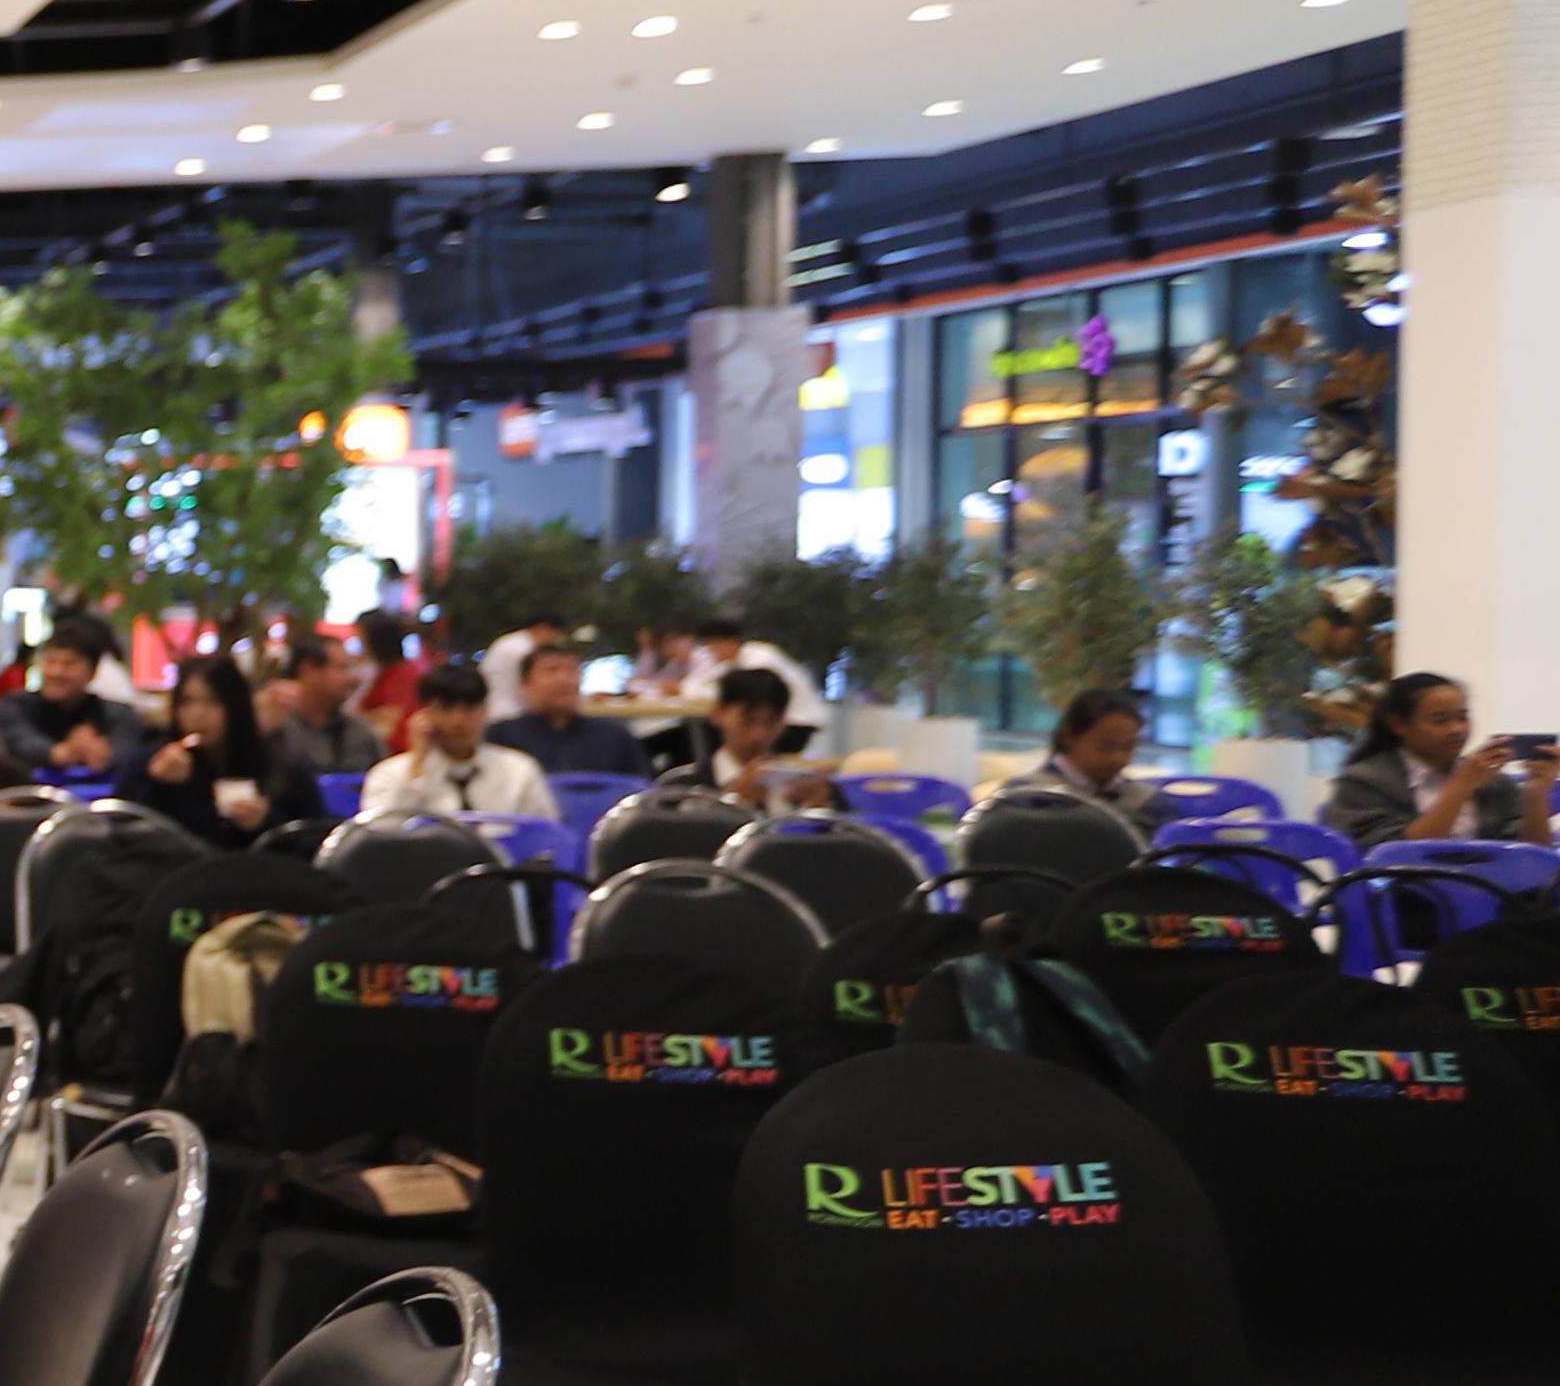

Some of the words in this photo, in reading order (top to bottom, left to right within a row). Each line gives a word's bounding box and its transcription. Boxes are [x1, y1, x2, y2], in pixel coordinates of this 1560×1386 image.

[1101, 912, 1143, 944] R
[1144, 914, 1280, 940] LIFESTYLE
[314, 962, 357, 1001] R
[358, 963, 500, 996] LIFESTYLE
[834, 980, 878, 1018] R
[1461, 987, 1516, 1022] R
[548, 1027, 601, 1074] R
[603, 1031, 775, 1067] LIFESTYLE
[1206, 1042, 1268, 1085] R
[1268, 1045, 1463, 1083] LIFESTYLE
[1274, 1079, 1318, 1095] EAT
[1406, 1085, 1466, 1101] PLAY
[804, 1162, 880, 1218] R
[881, 1162, 1118, 1207] LIFESTYLE
[887, 1209, 939, 1229] EAT
[954, 1208, 1035, 1229] SHOP
[1048, 1204, 1122, 1225] PLAY
